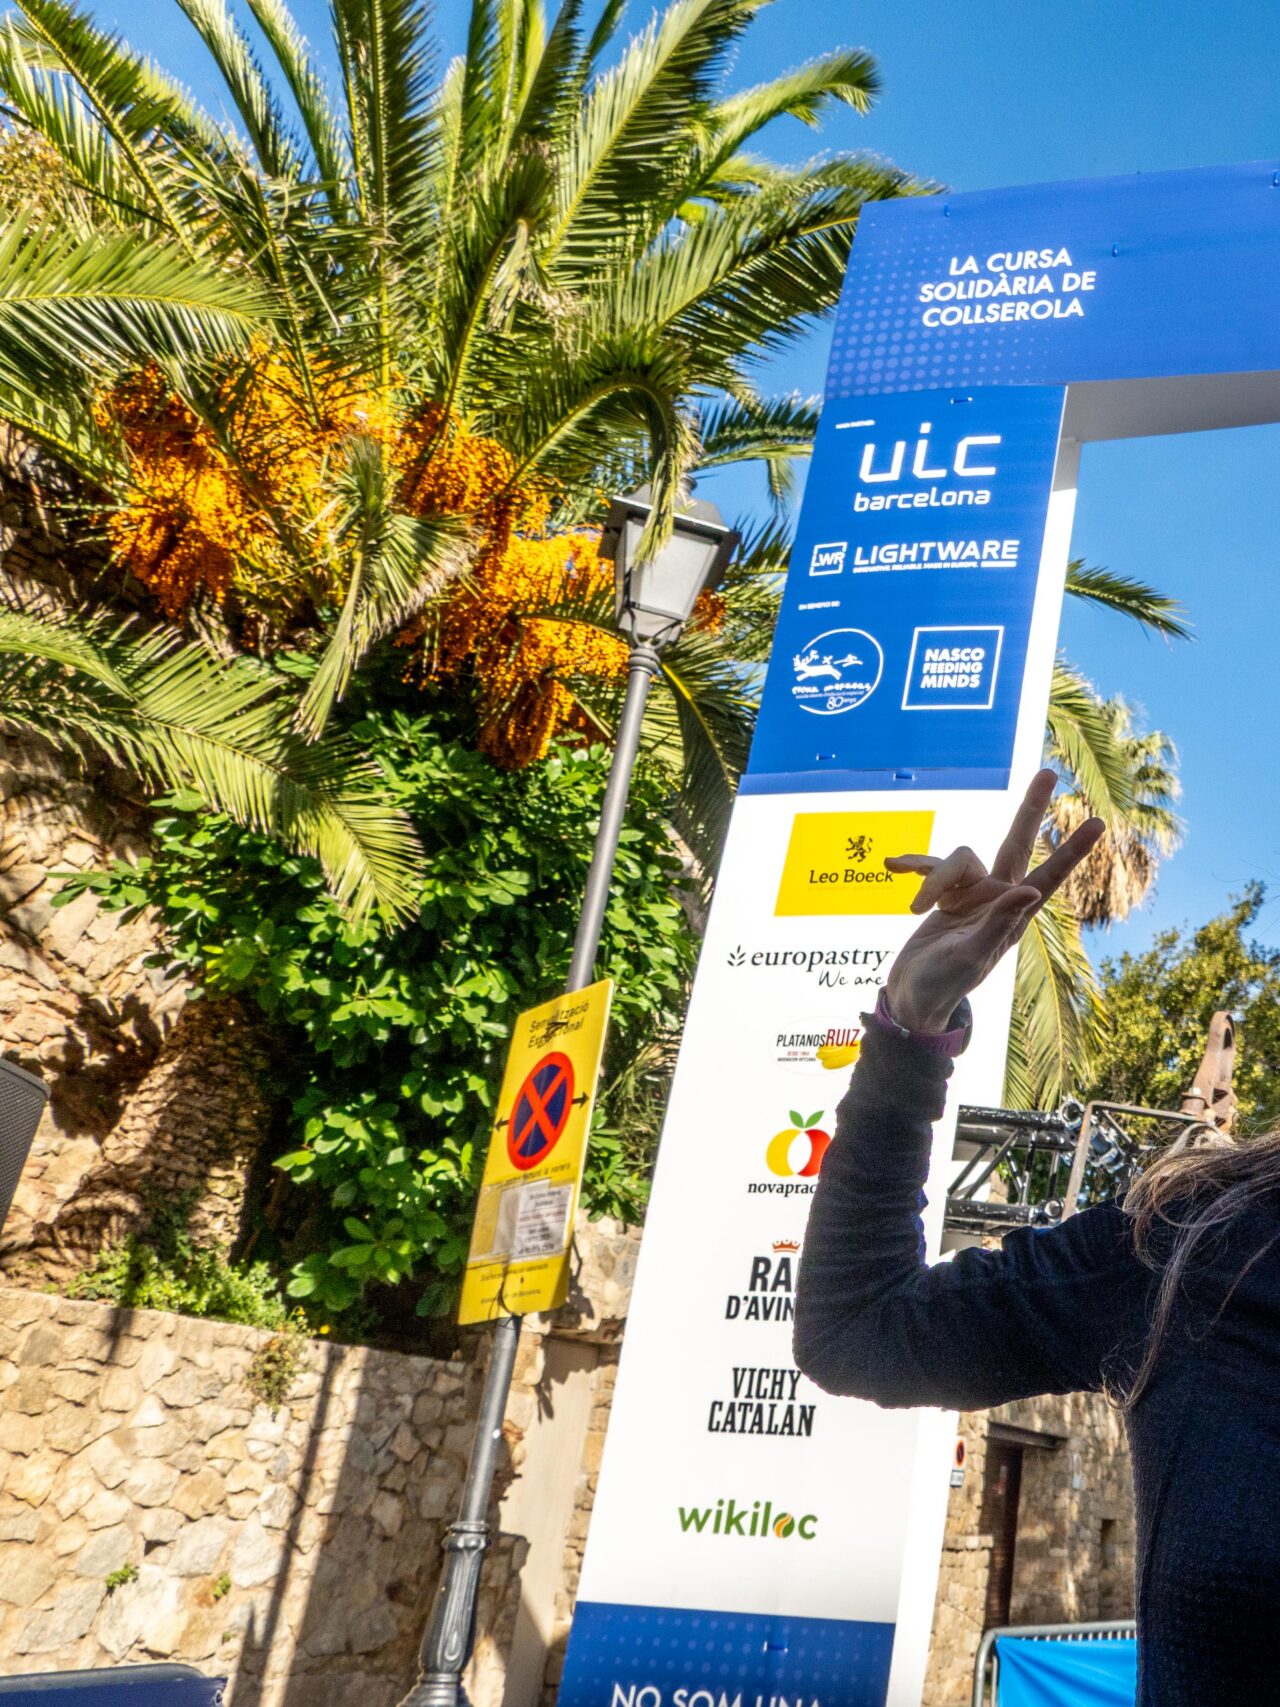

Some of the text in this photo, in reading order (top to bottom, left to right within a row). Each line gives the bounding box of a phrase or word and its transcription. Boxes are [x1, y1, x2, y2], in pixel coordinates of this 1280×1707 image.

[949, 248, 1072, 276] LA CURSA
[919, 271, 1096, 303] SOLIDÀRIA DE
[922, 298, 1084, 327] COLLSEROLA
[853, 487, 991, 512] barcelona
[854, 539, 1020, 566] LIGHTWARE
[924, 647, 985, 661] NASCO
[922, 661, 984, 674] FEEDING
[920, 674, 981, 689] MINDS
[809, 868, 893, 883] Leo Boeck
[751, 947, 890, 972] europastry
[818, 969, 885, 988] We are
[748, 1256, 801, 1293] RA
[732, 1366, 802, 1400] VICHY
[707, 1400, 816, 1437] CATALAN
[677, 1498, 819, 1540] wikiloc
[611, 1682, 661, 1707] NO
